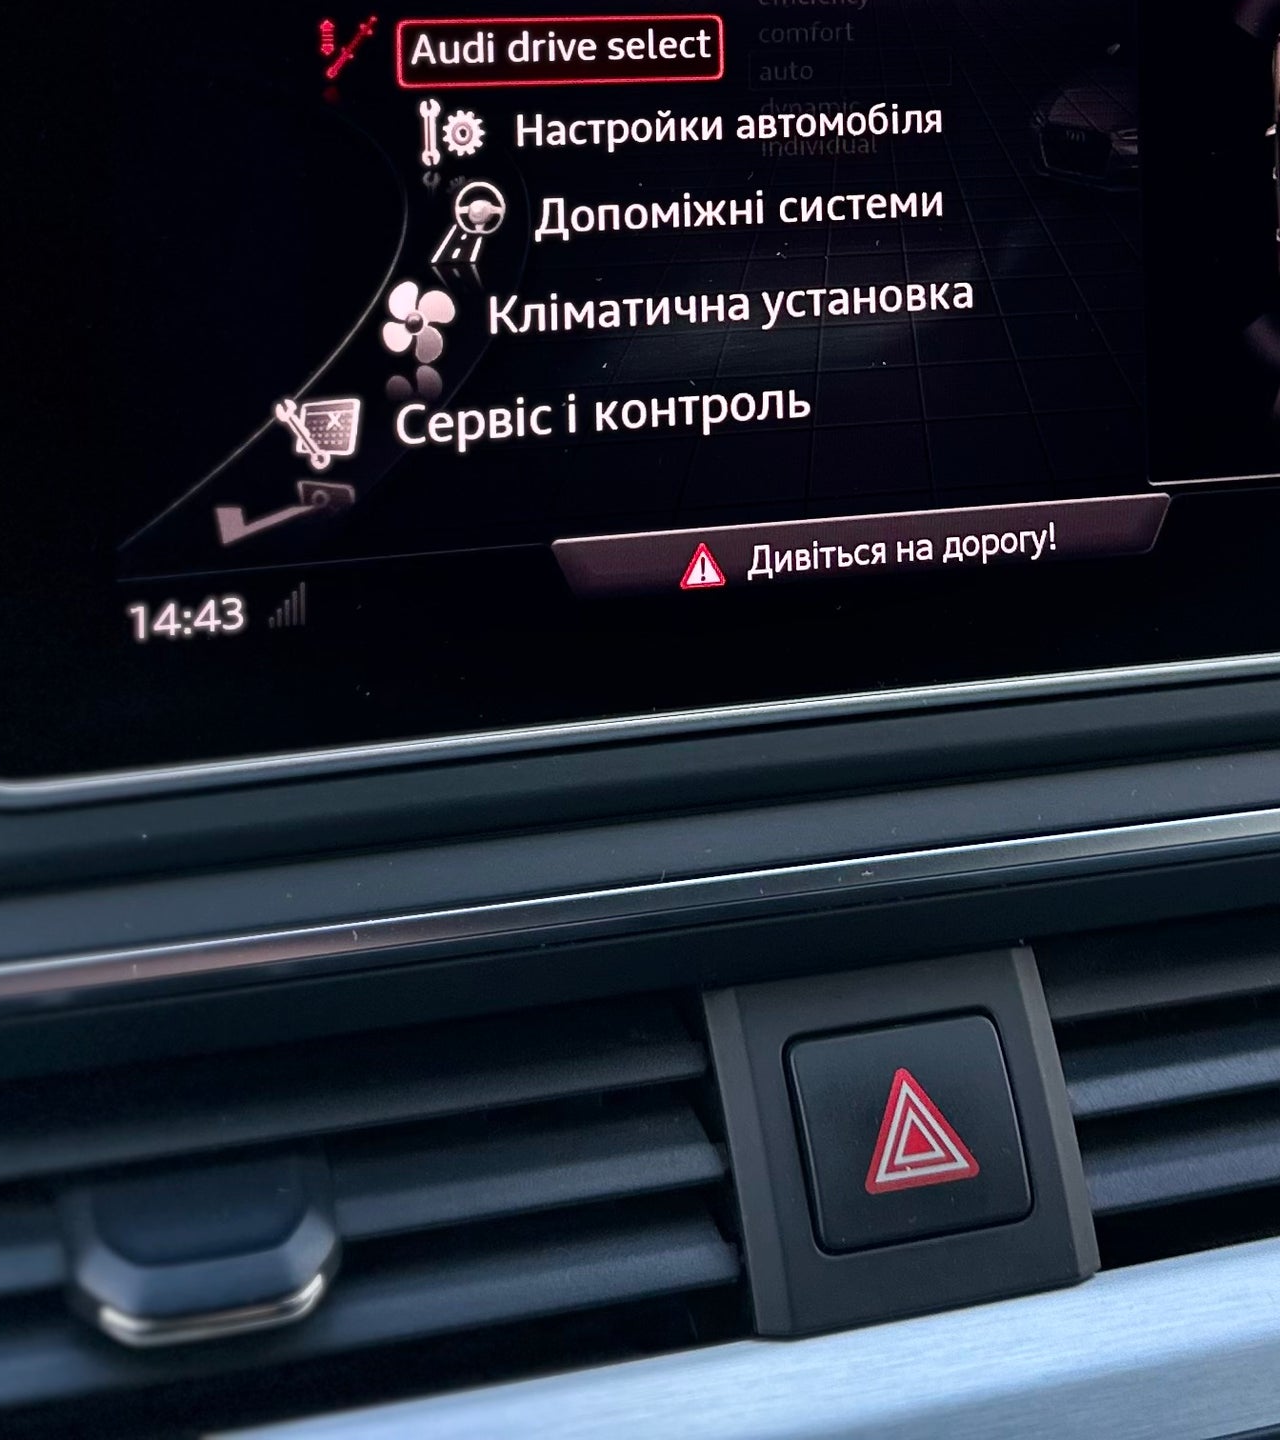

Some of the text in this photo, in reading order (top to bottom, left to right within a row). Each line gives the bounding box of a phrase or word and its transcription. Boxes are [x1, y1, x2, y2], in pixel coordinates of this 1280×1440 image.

[410, 26, 712, 65] Audi drive select
[757, 20, 856, 44] comfort
[758, 60, 815, 82] auto
[515, 102, 944, 153] Настройки автомобіля
[761, 134, 878, 158] individual
[534, 190, 945, 242] Допоміжні системи
[488, 280, 974, 335] Кліматична установка
[395, 397, 552, 452] Сервіс
[594, 387, 812, 436] контроль
[746, 522, 1058, 581] Дивіться на дорогу!
[128, 596, 245, 641] 14:43
